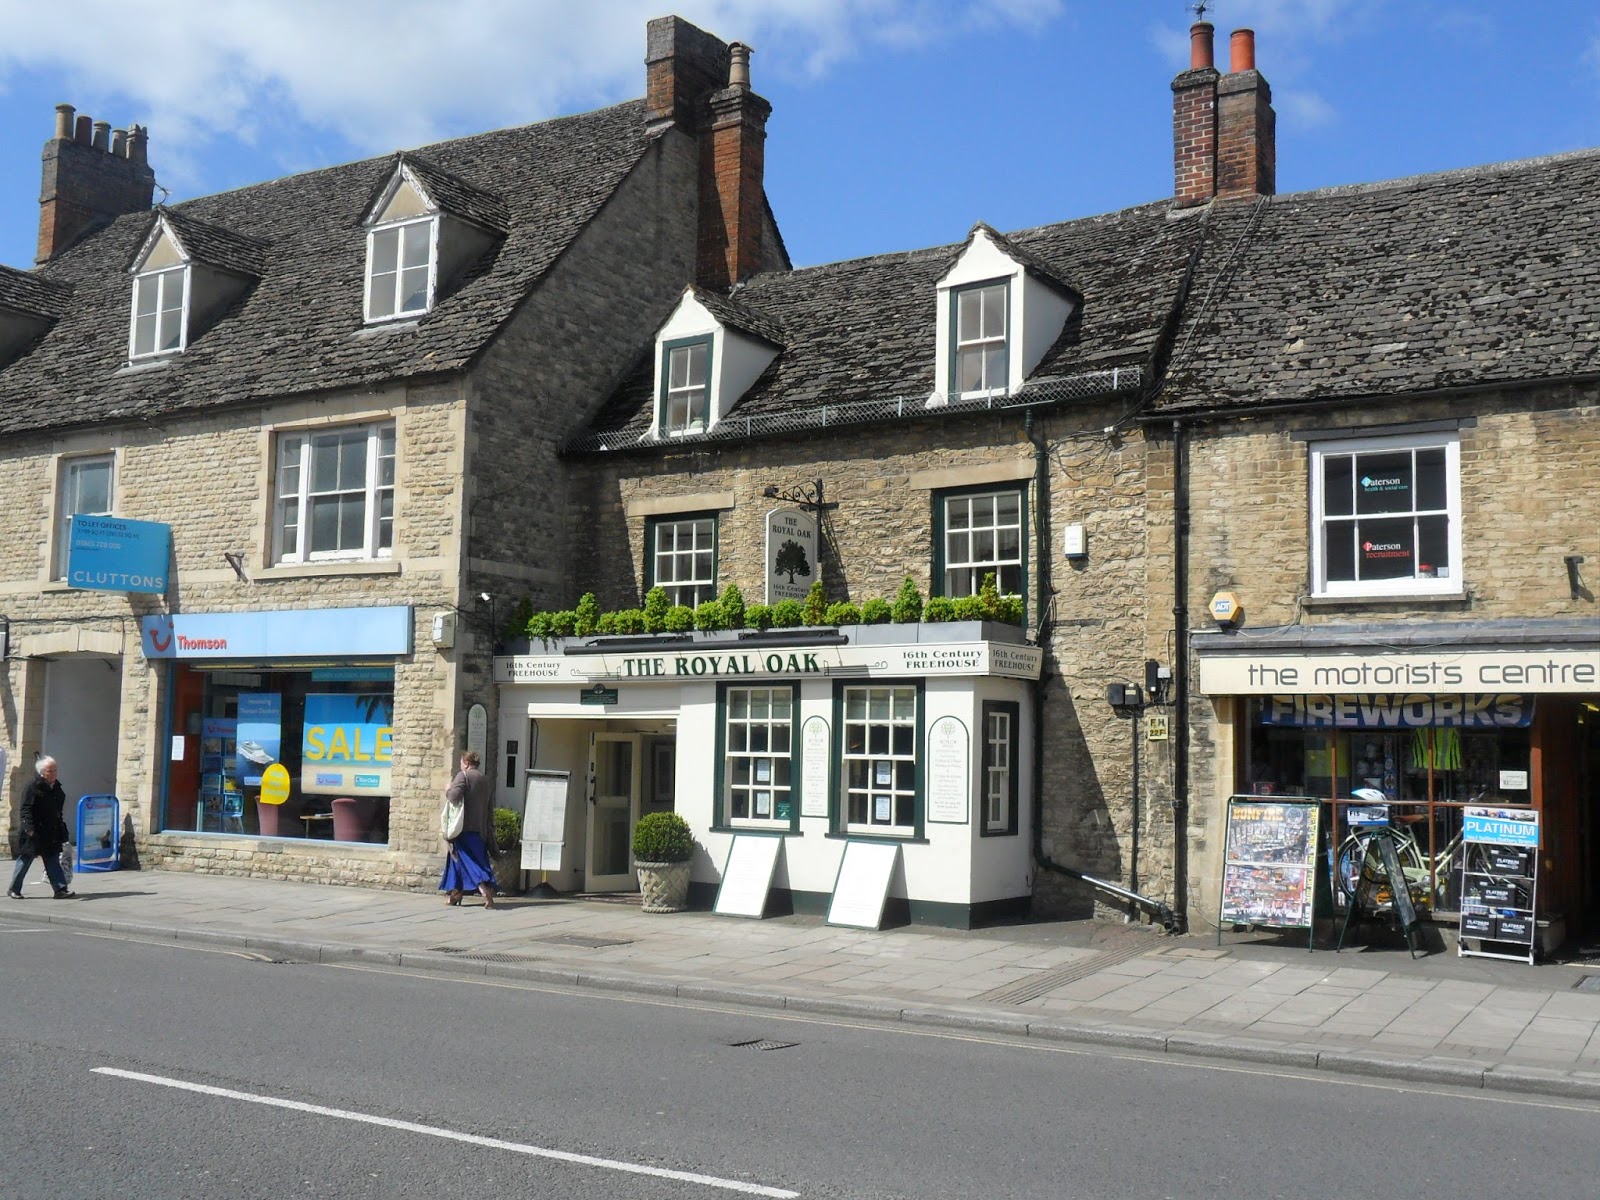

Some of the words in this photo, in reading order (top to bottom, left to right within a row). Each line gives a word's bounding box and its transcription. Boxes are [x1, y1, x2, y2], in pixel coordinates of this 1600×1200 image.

[1366, 478, 1401, 486] Paterson
[100, 522, 127, 530] OFFICES
[784, 516, 798, 527] THE
[772, 525, 795, 536] ROYAL
[797, 529, 812, 539] OAK
[1366, 543, 1401, 551] Paterson
[1366, 550, 1410, 558] recruitment
[74, 570, 164, 588] CLUTTONS
[1215, 602, 1230, 612] ADT
[177, 634, 227, 650] Thomson
[903, 651, 928, 659] 16th
[933, 649, 983, 659] Century
[992, 649, 1008, 659] 16th
[1010, 651, 1038, 662] Century
[526, 661, 561, 671] Century
[623, 657, 667, 677] THE
[675, 655, 756, 677] ROYAL
[766, 653, 821, 673] OAK
[906, 659, 980, 669] FREEHOUSE
[994, 660, 1036, 672] FREEHOUSE
[1248, 664, 1298, 686] the
[1314, 661, 1463, 686] motorists
[1479, 659, 1595, 684] centre
[1271, 693, 1524, 727] FIREWORKS
[305, 726, 394, 761] SALE
[1466, 821, 1535, 836] PLATINUM
